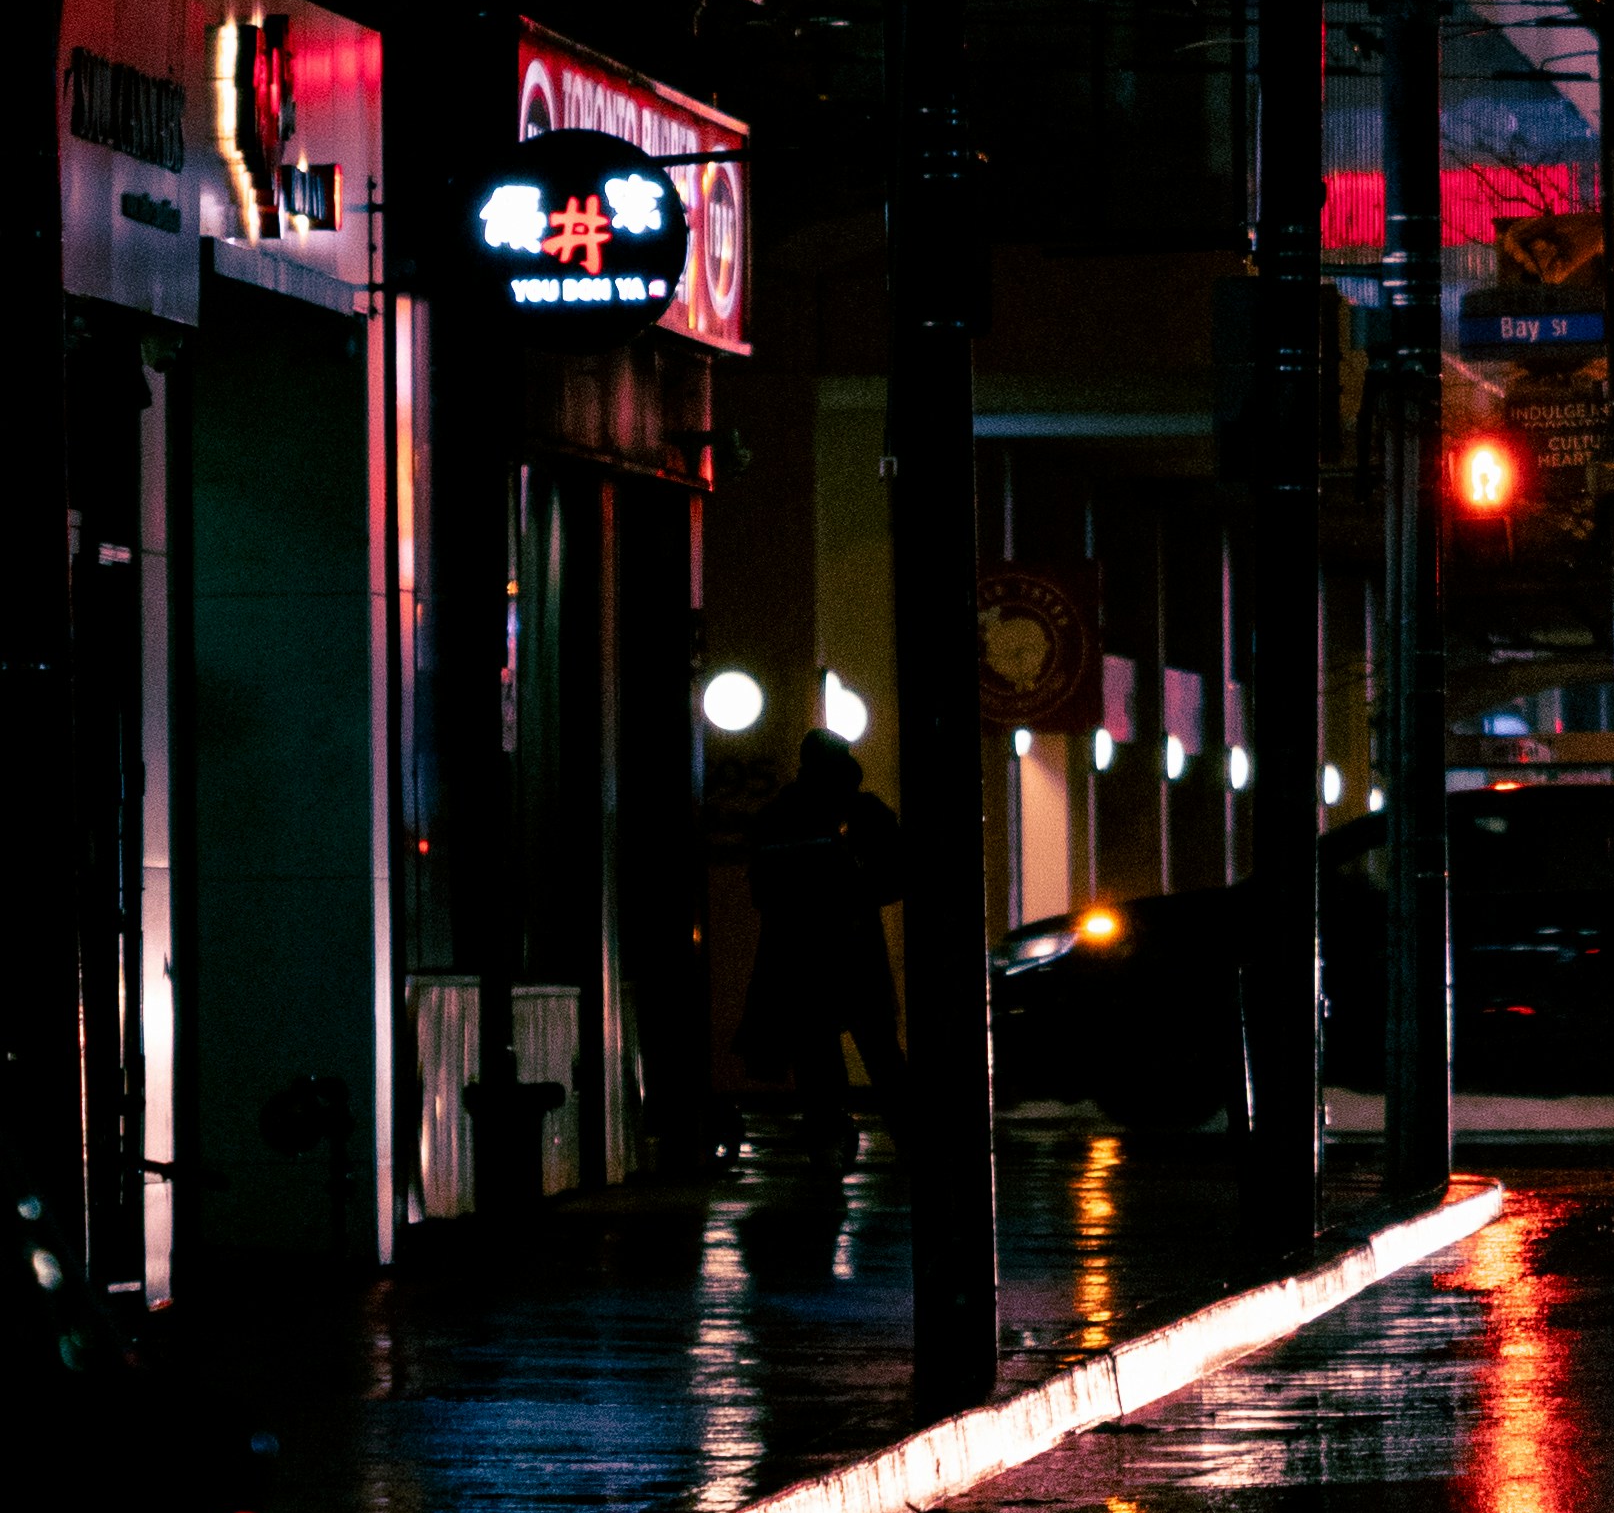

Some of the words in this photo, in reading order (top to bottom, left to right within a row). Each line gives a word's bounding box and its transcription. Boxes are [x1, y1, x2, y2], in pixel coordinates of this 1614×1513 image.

[510, 277, 560, 303] YOU
[615, 277, 647, 301] YA
[1499, 315, 1541, 344] Bay
[1550, 317, 1569, 338] St
[1510, 402, 1586, 421] INDULGE
[1547, 433, 1602, 451] CULTU
